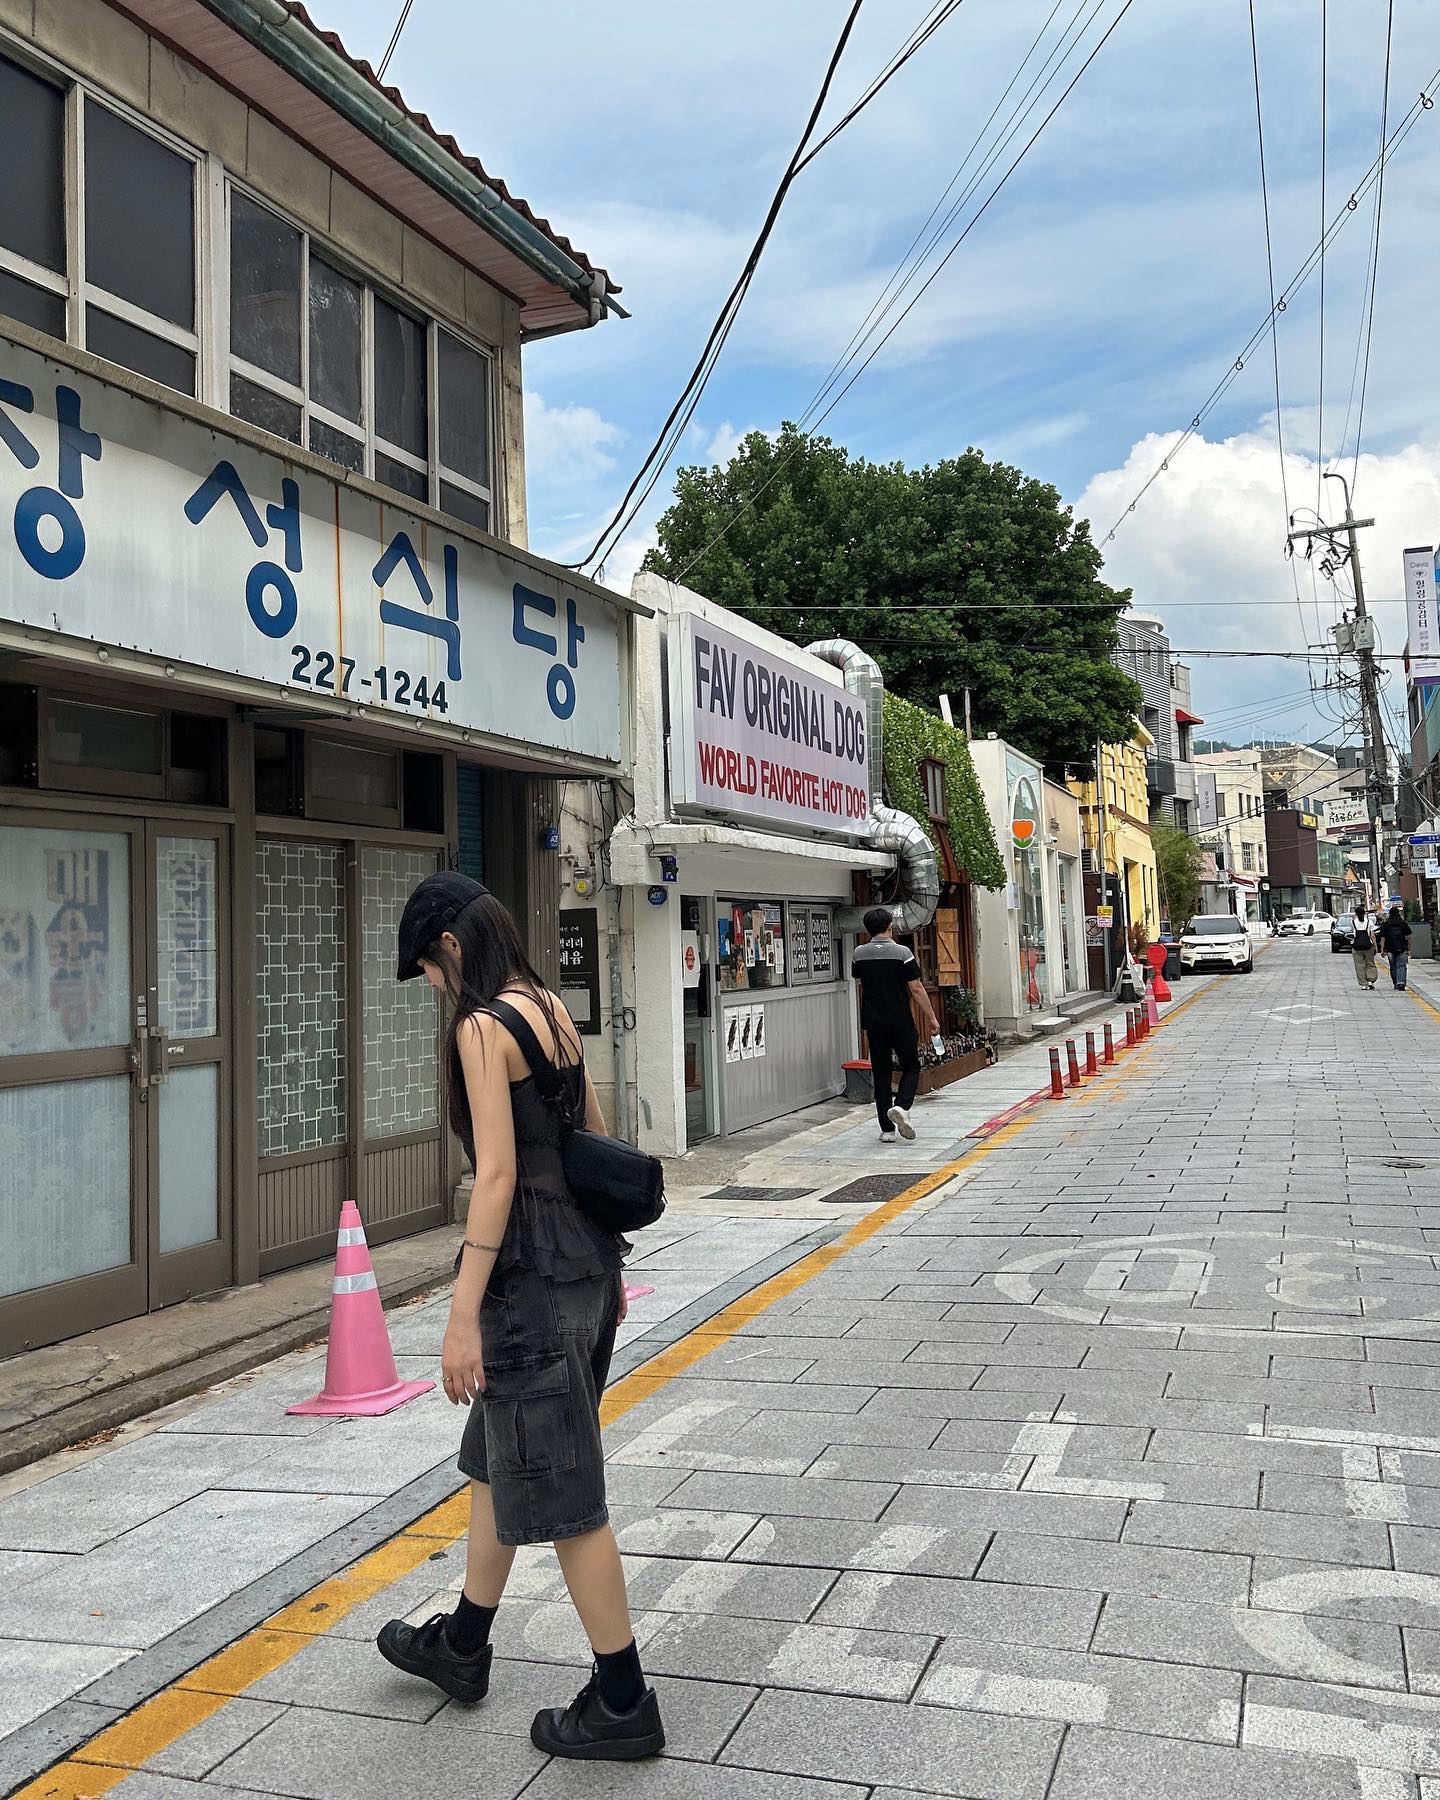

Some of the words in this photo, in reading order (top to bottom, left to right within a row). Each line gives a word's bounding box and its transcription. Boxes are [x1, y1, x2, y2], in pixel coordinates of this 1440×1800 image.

[291, 645, 448, 714] 227-1244
[695, 635, 737, 719] FAV
[743, 660, 831, 753] ORIGINAL
[834, 700, 865, 765] DOG
[698, 741, 757, 796] WORLD
[760, 760, 820, 811] FAVORITE
[822, 778, 843, 815] HOT
[846, 785, 867, 821] DOG
